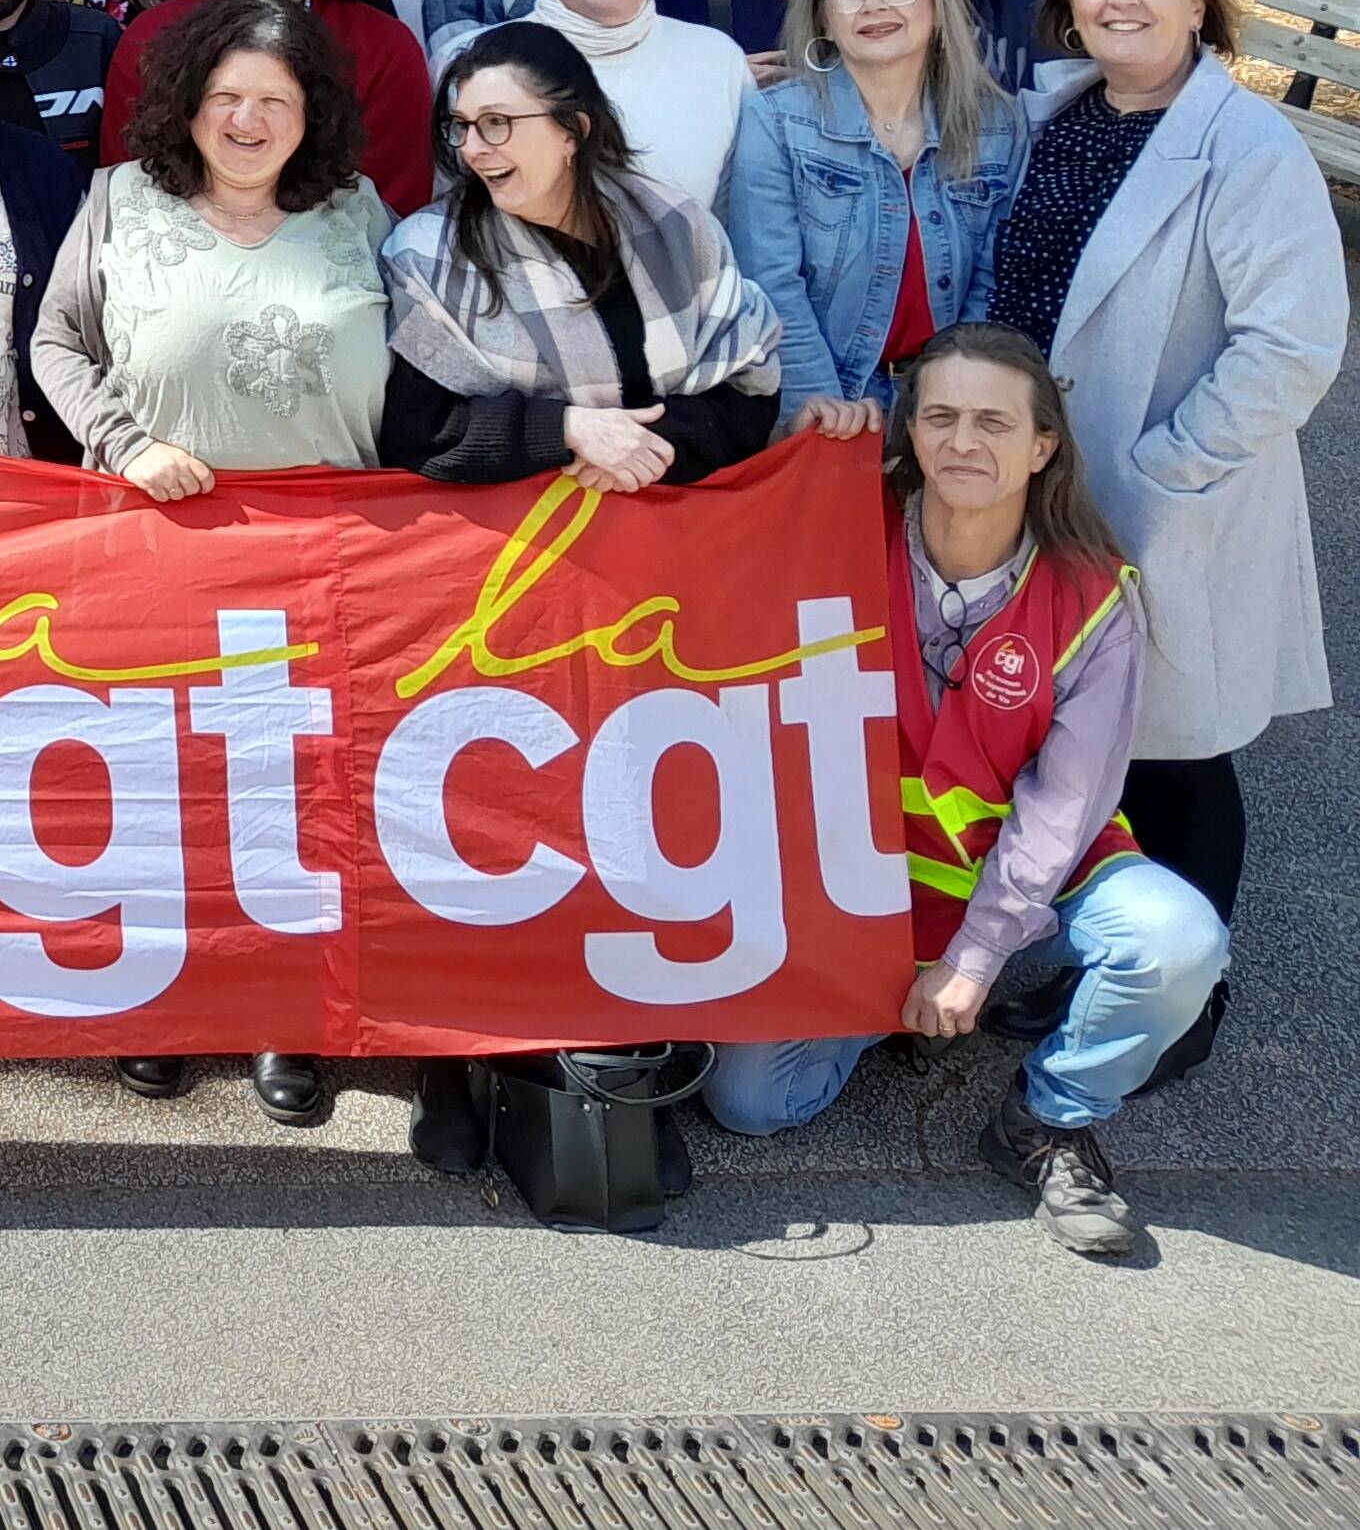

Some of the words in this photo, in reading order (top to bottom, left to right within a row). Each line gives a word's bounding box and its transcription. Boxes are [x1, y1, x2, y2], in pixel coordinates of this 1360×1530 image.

[395, 473, 886, 699] la
[995, 651, 1025, 675] cgt
[373, 596, 912, 1005] cgt
